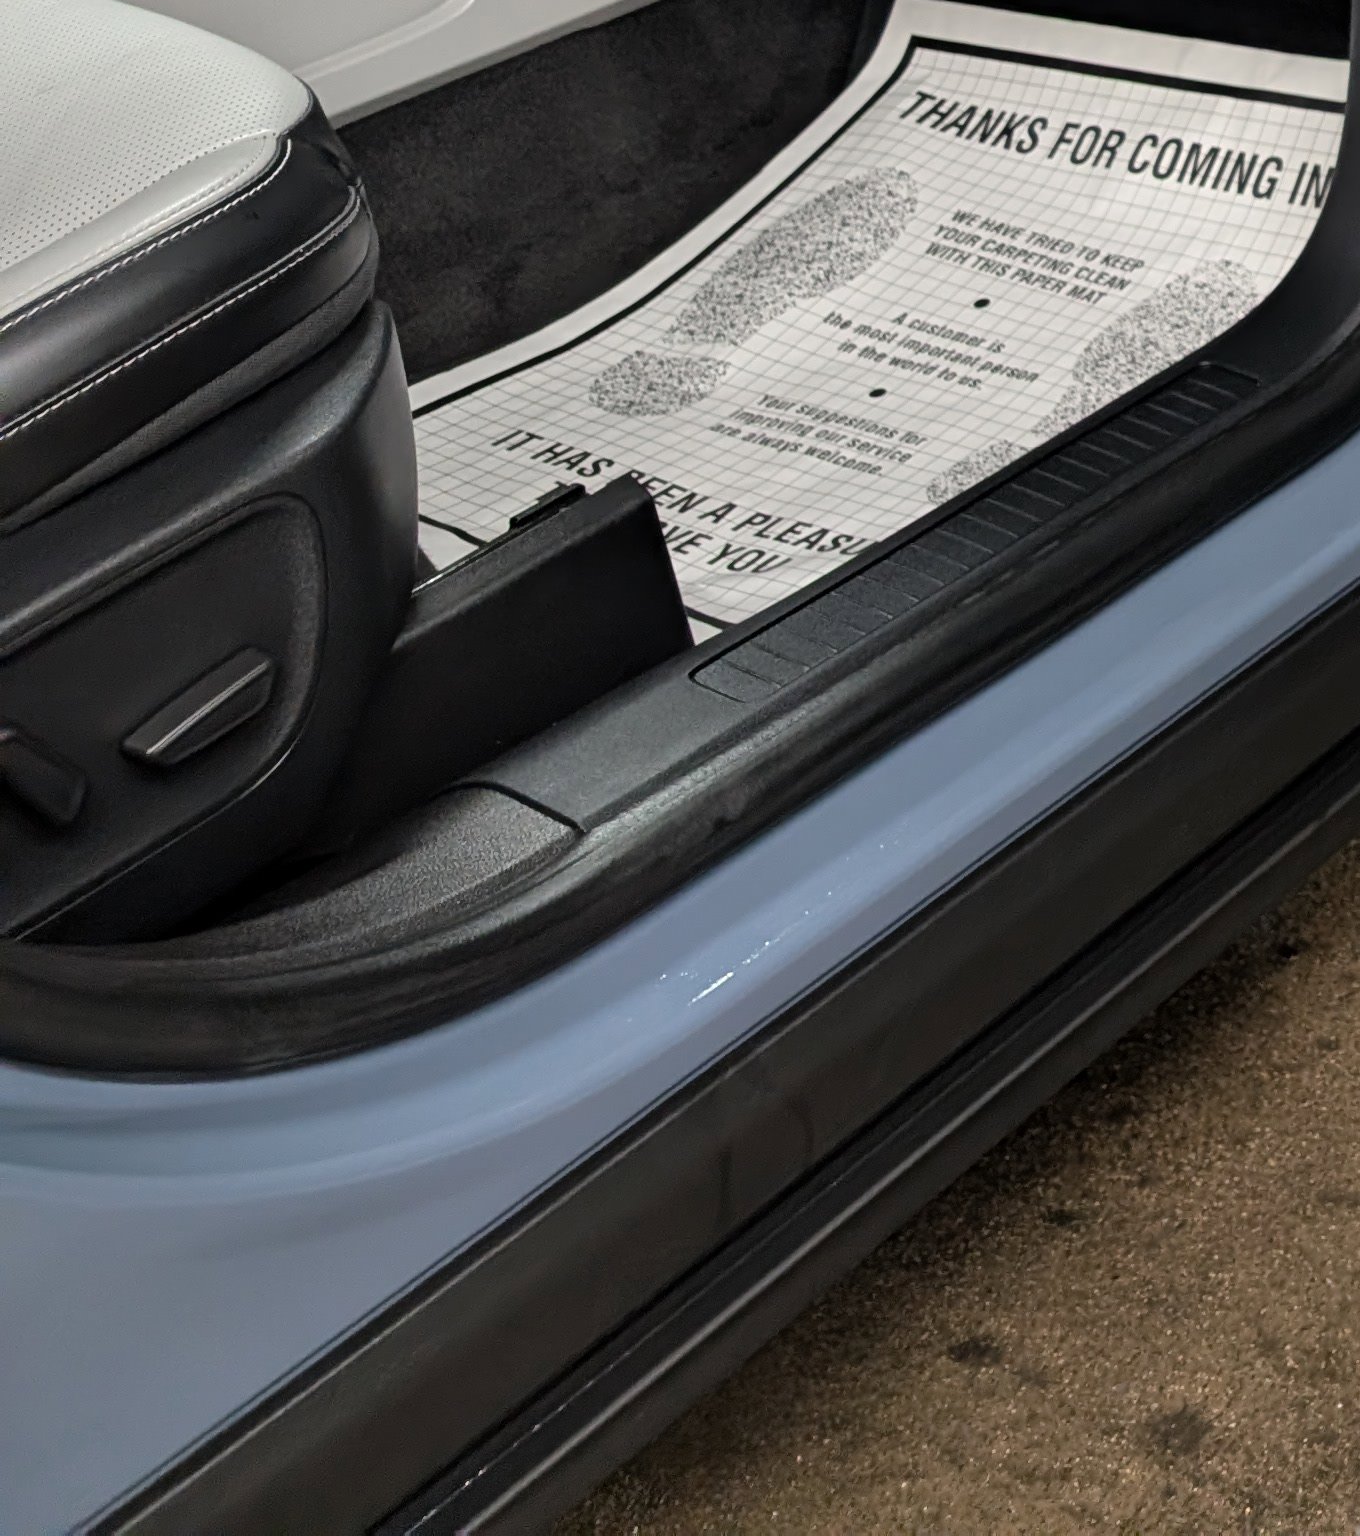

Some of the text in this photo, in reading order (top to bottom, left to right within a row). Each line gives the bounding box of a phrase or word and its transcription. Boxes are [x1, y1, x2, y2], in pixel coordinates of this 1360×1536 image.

[899, 90, 1336, 208] THANKS FOR COMING IN
[933, 224, 1131, 291] YOUR CARPETING CLEAN
[951, 209, 1145, 273] WE HAVE TRIED TO KEEP
[925, 241, 1107, 306] WITH THIS PAPER MAT
[822, 310, 1039, 383] the most important person
[891, 312, 1006, 354] A customer is
[837, 338, 983, 390] in the world to us.
[709, 423, 883, 476] are always welcome.
[729, 408, 913, 463] improving our service
[756, 393, 928, 447] Your suggestions for
[490, 429, 545, 451] IT
[530, 441, 615, 478] HAS
[702, 502, 736, 524] A
[707, 543, 793, 575] YOU
